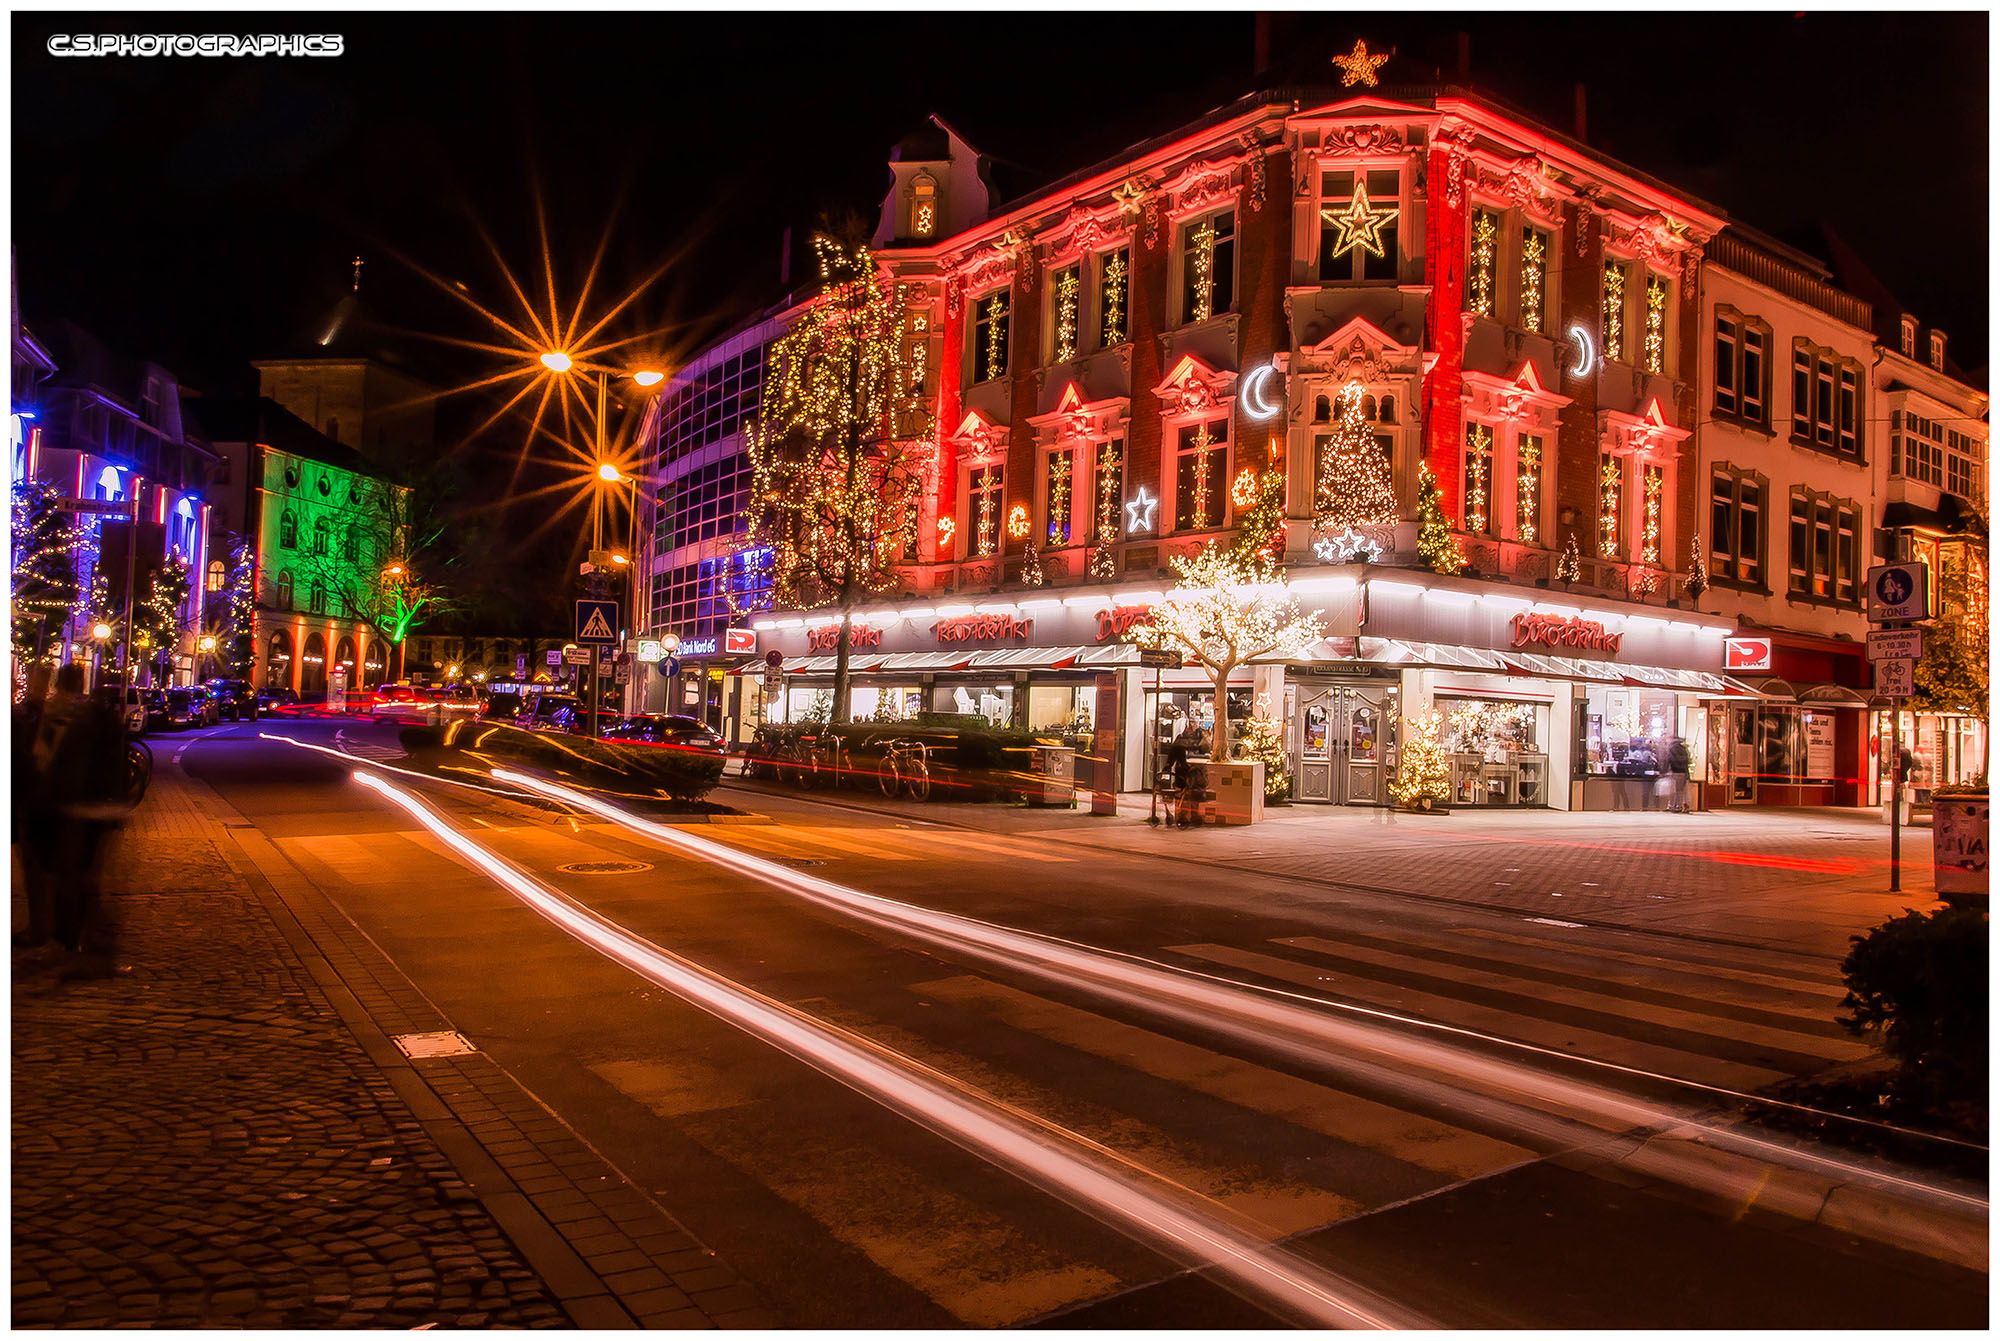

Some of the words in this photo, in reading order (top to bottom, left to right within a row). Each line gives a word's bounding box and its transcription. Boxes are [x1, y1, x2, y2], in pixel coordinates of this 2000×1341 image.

[1881, 606, 1910, 618] ZONE
[683, 640, 694, 655] Bank
[694, 638, 707, 654] Nord
[707, 638, 716, 653] eG
[1885, 676, 1902, 685] frei
